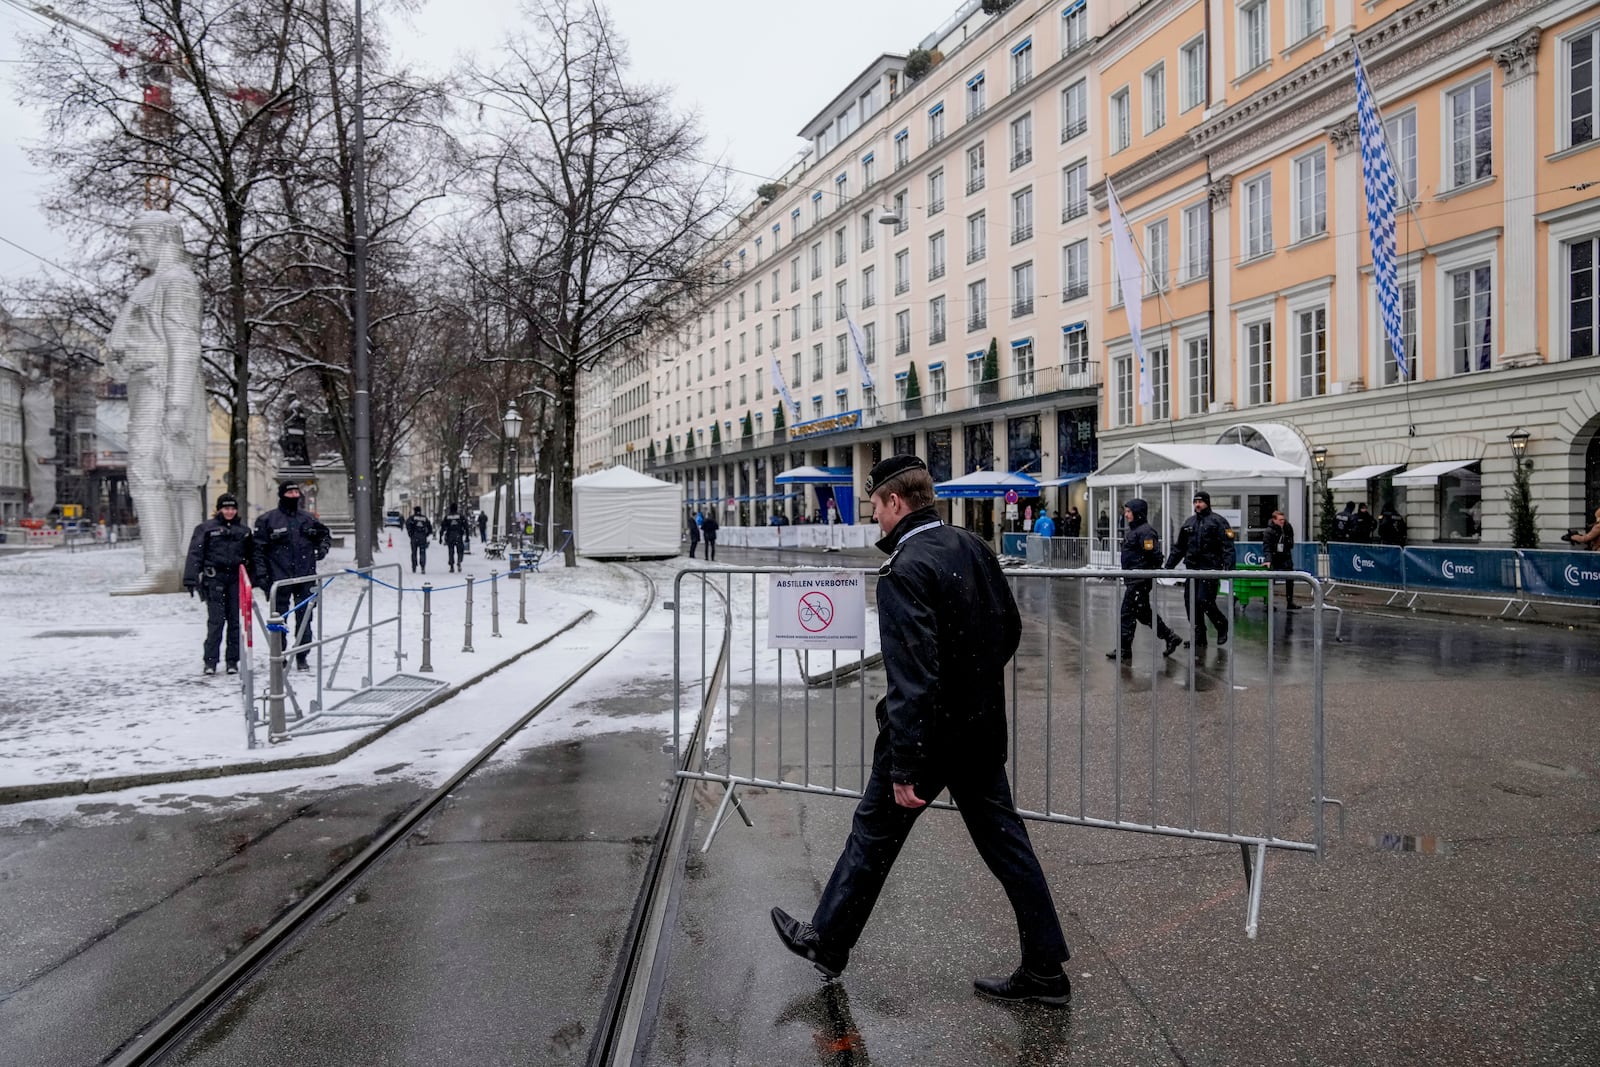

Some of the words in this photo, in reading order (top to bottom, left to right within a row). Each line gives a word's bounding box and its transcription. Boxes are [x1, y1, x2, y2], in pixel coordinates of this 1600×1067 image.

[1362, 560, 1374, 568] msc
[1455, 564, 1474, 574] msc
[815, 579, 858, 587] VERBOTEN!
